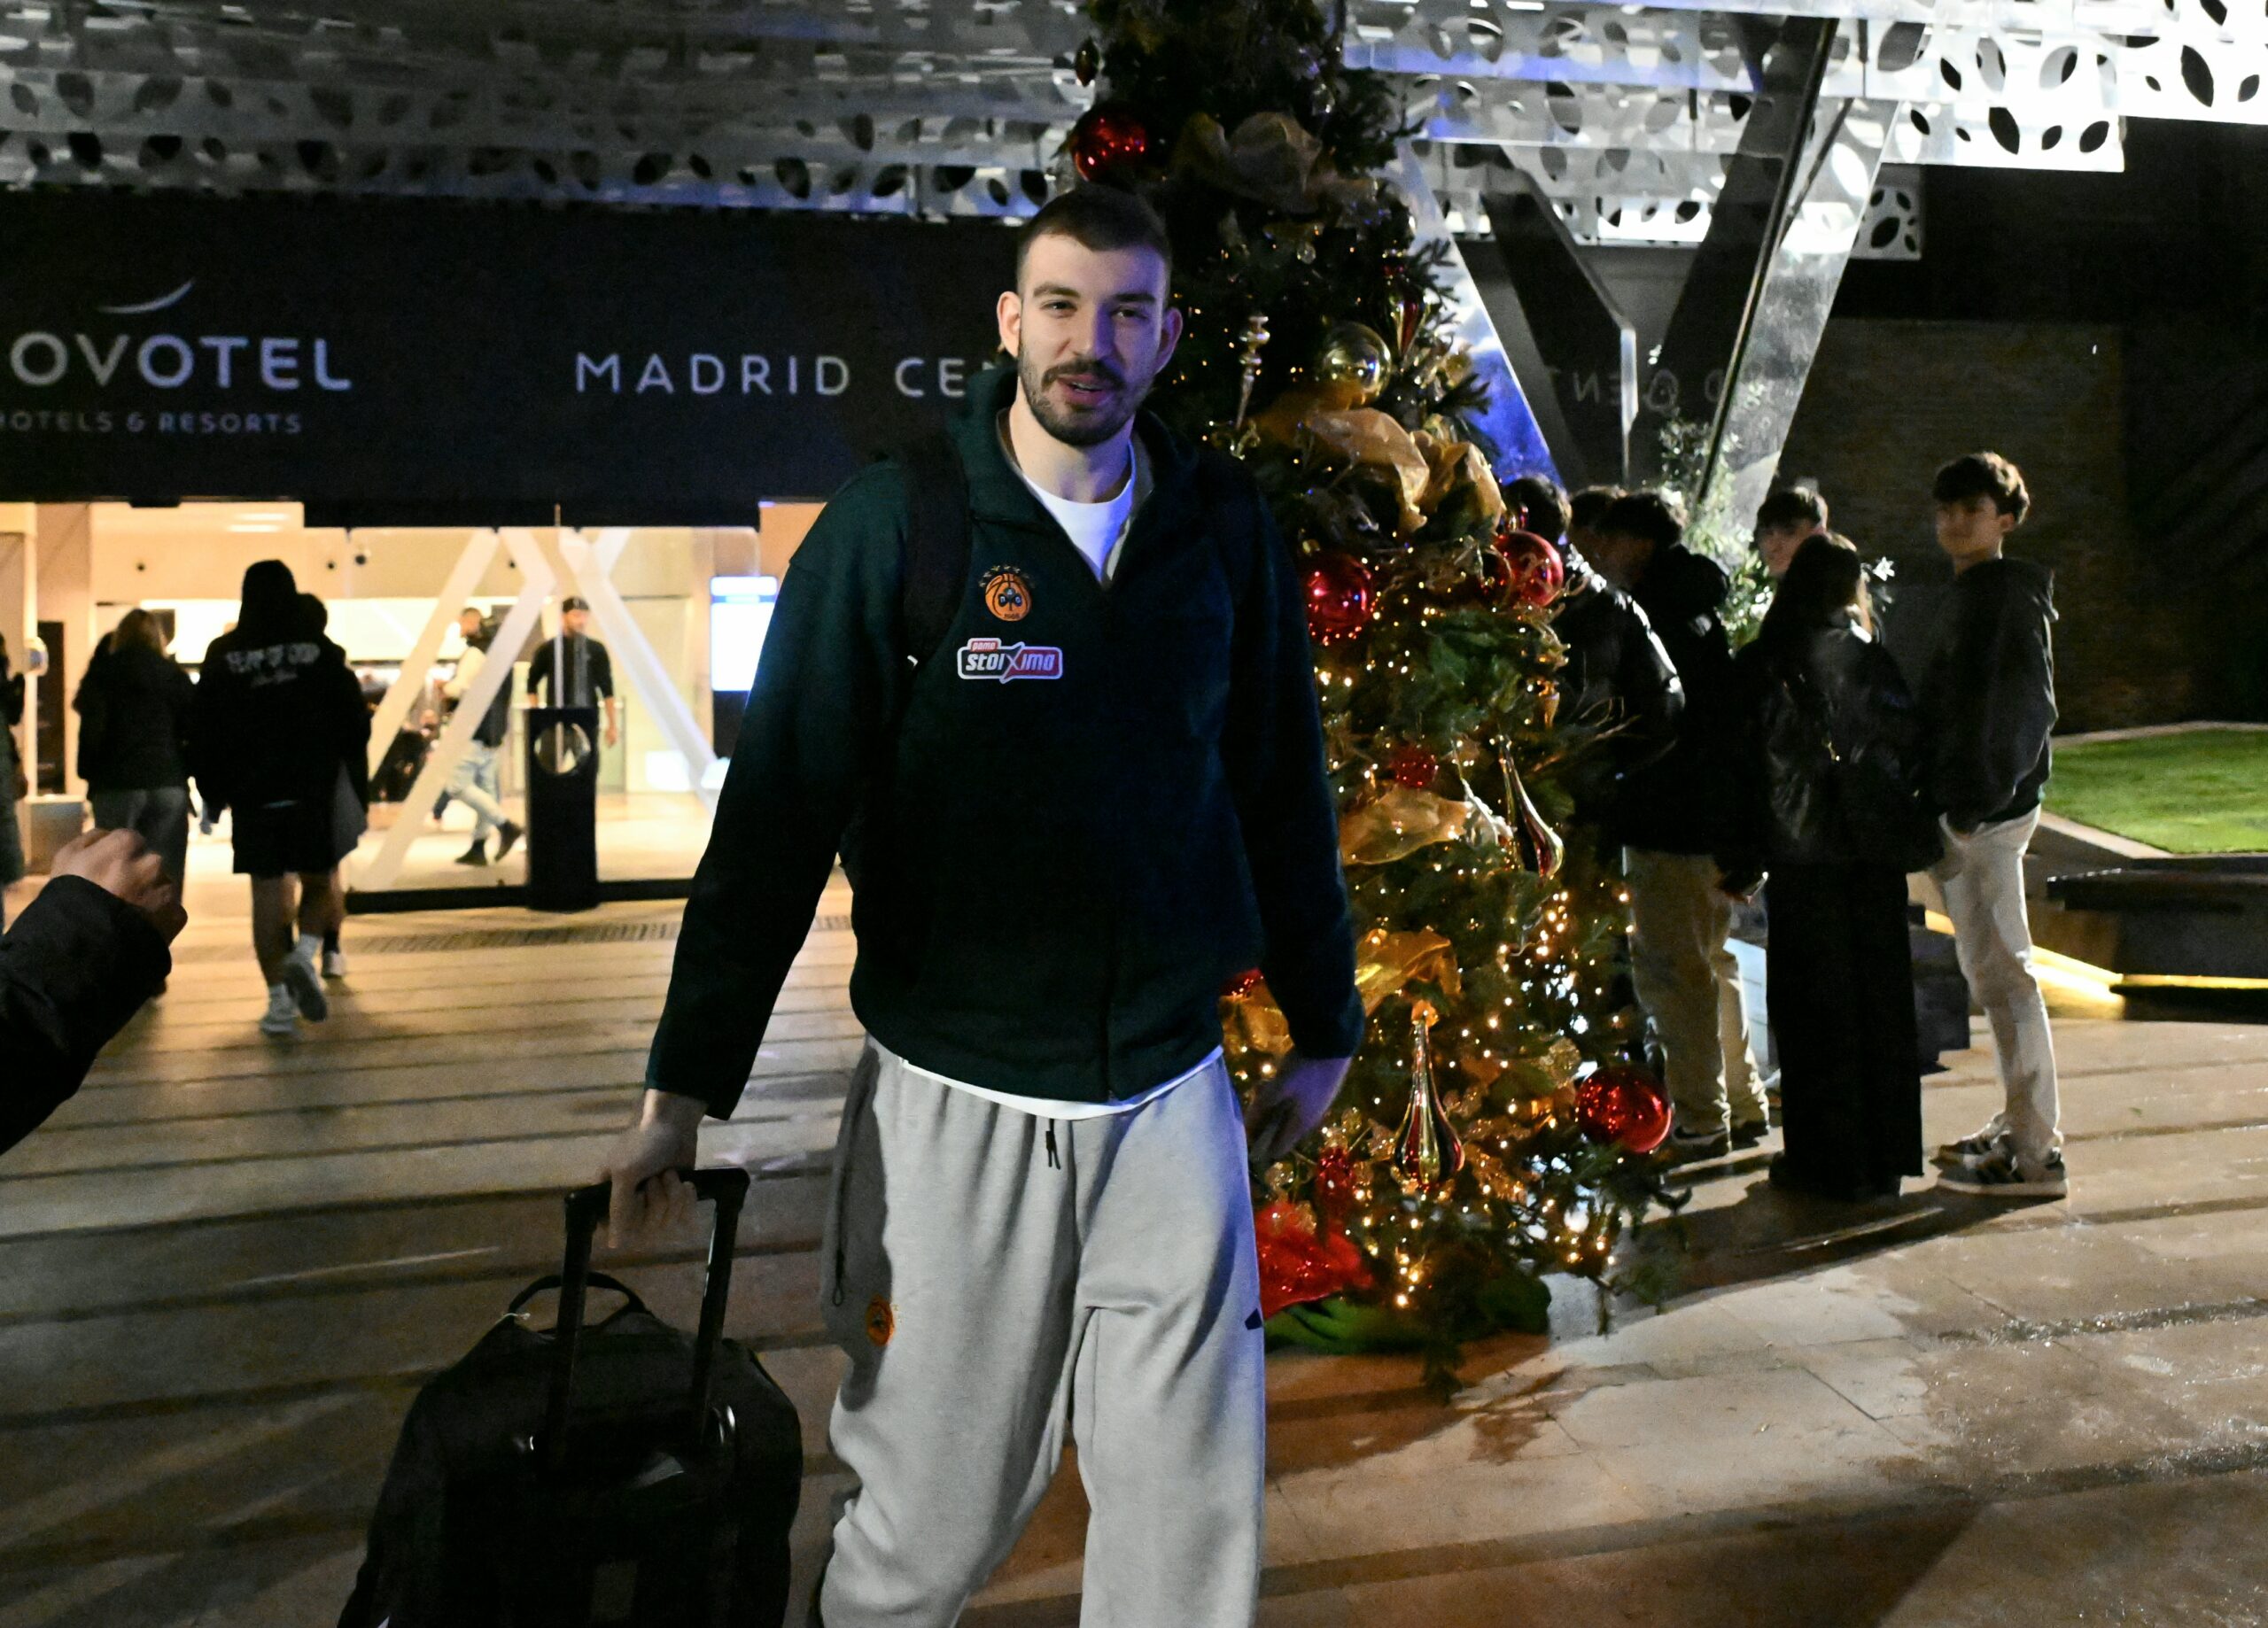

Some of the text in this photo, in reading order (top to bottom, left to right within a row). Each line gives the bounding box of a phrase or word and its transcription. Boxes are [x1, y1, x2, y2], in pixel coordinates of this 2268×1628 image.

[576, 353, 997, 399] MADRID CE
[158, 410, 303, 435] RESORTS
